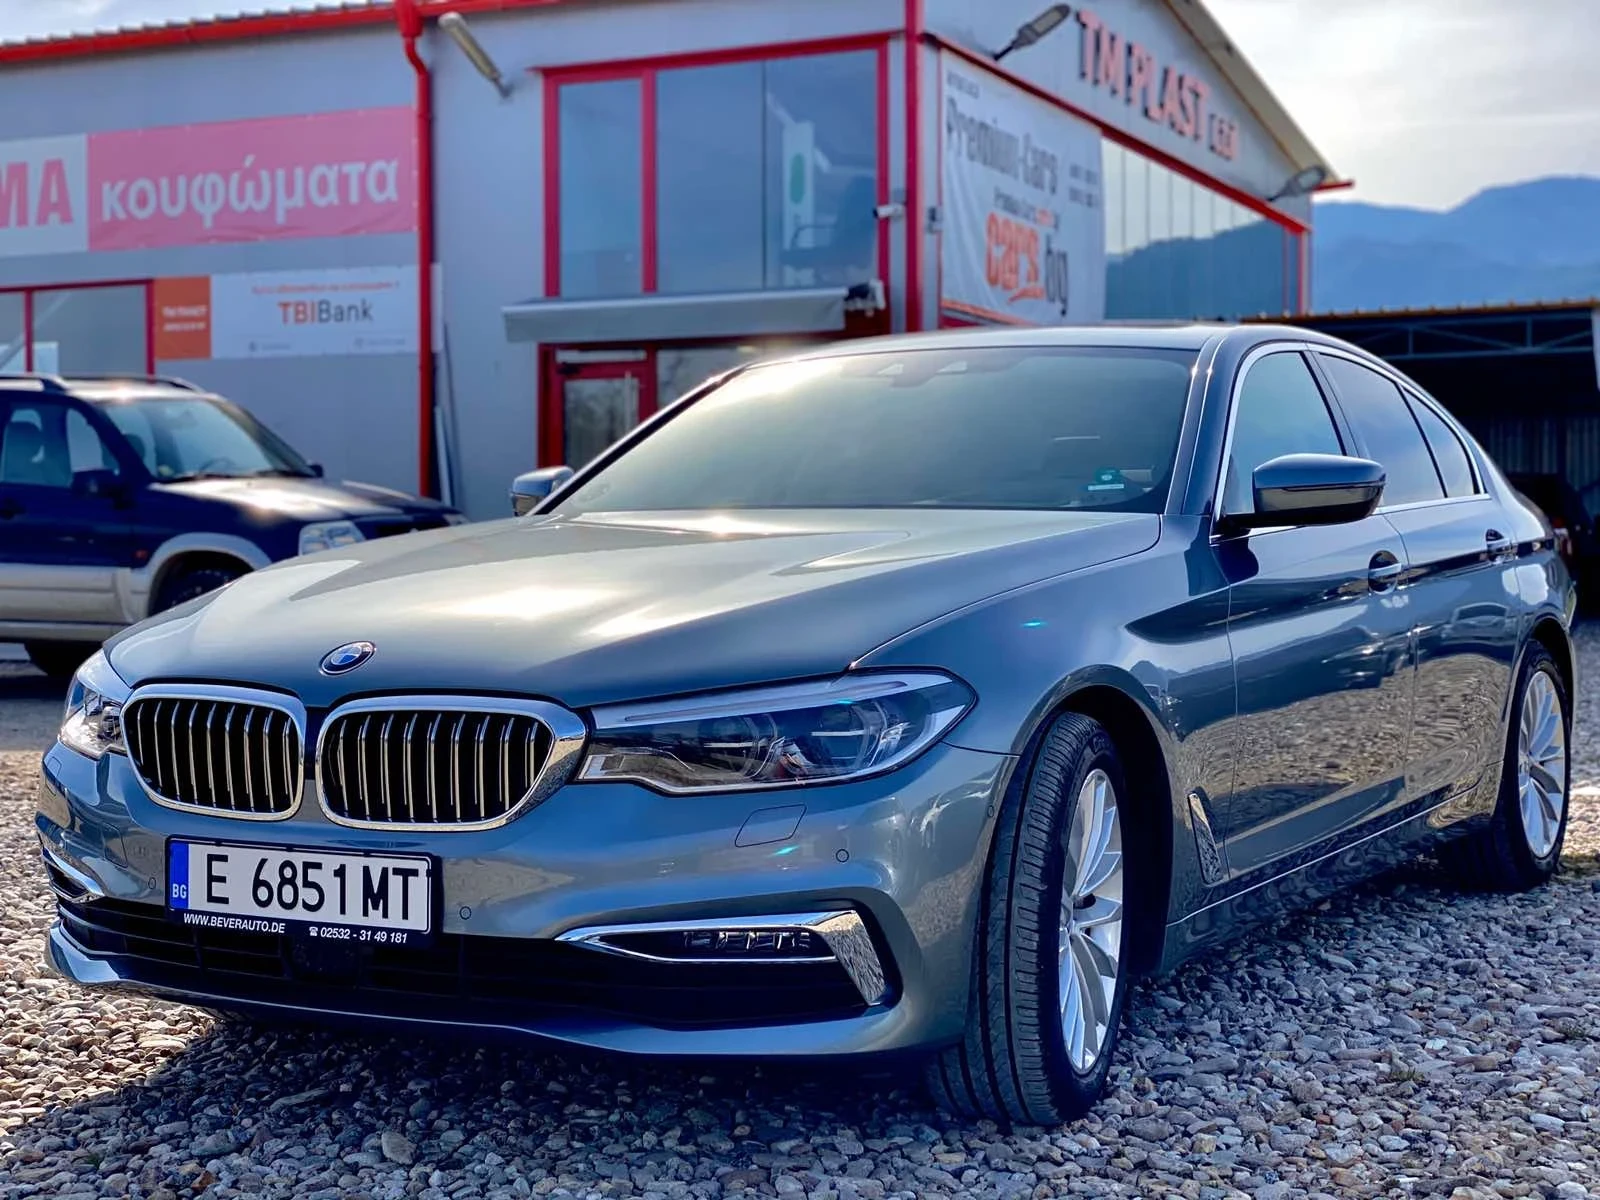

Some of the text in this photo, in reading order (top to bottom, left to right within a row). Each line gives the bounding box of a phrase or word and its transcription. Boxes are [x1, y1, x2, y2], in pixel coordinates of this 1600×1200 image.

[102, 155, 399, 228] κουφώματα
[278, 299, 373, 325] TBIBank
[172, 883, 187, 899] BG
[206, 853, 420, 921] E 6851 MT
[183, 912, 287, 934] WWW.BEVERAUTO.DE
[320, 926, 351, 940] 02532
[359, 929, 372, 941] 31
[374, 930, 388, 943] 49
[390, 931, 408, 944] 181
